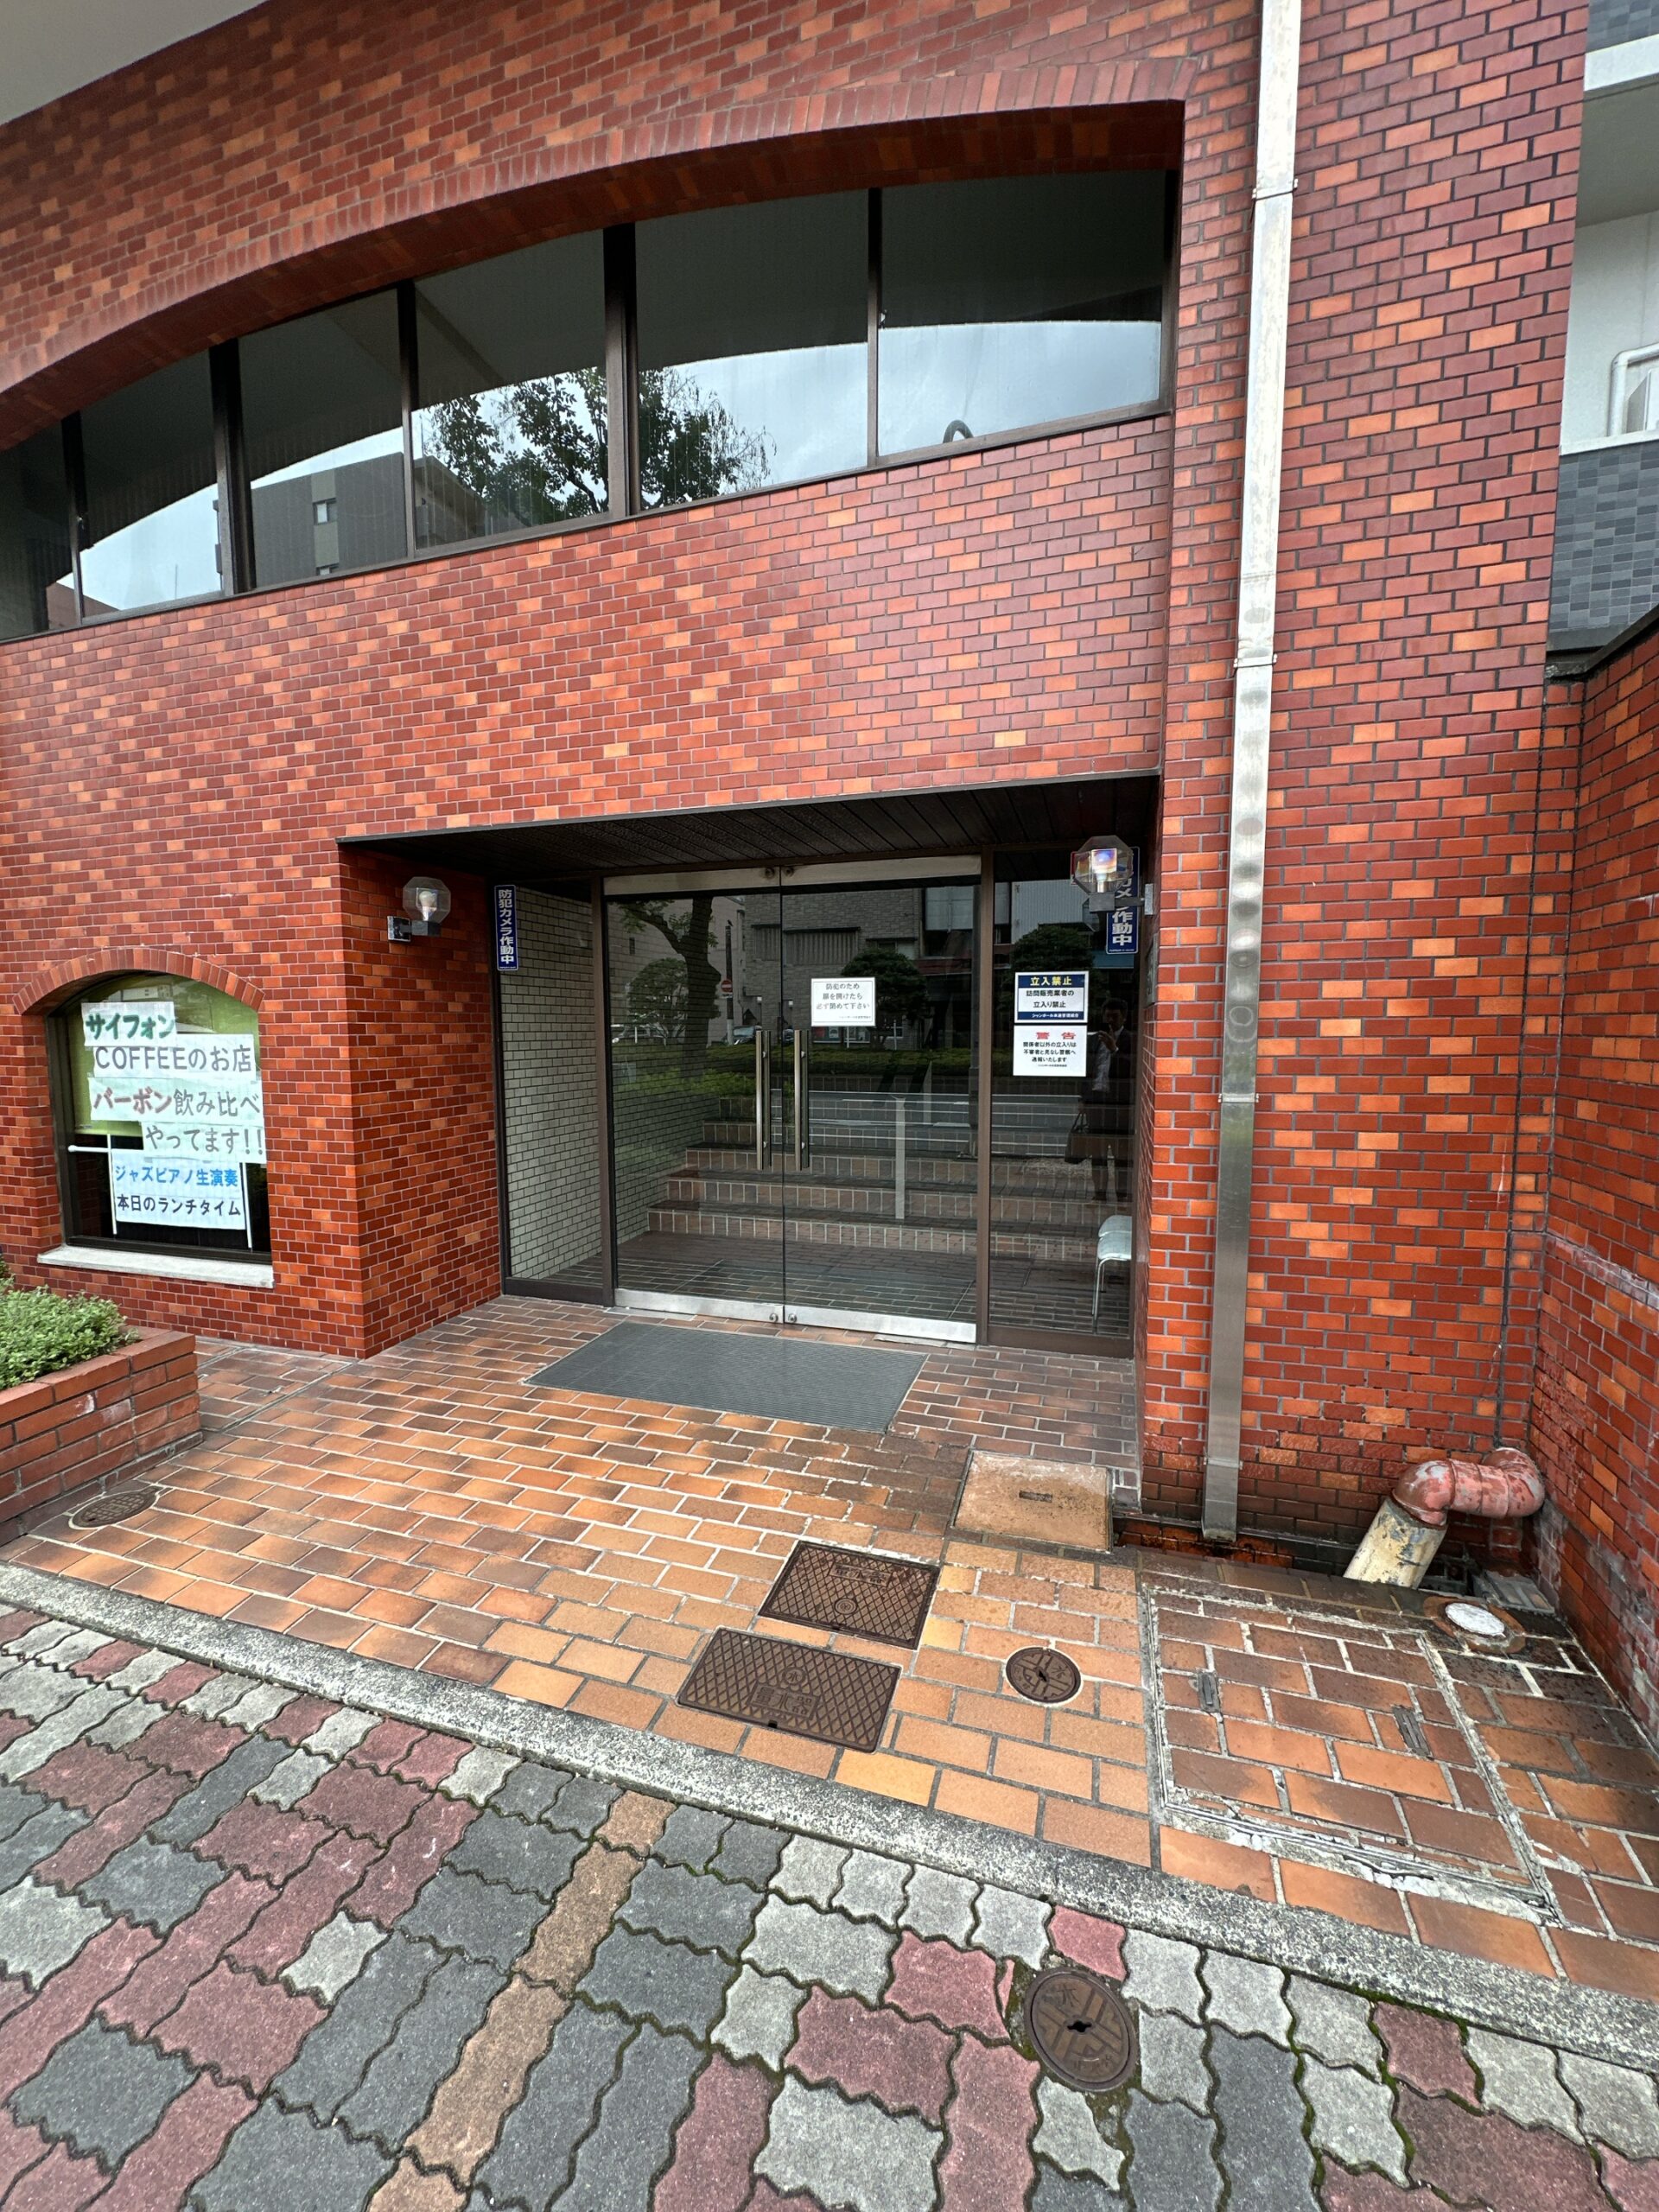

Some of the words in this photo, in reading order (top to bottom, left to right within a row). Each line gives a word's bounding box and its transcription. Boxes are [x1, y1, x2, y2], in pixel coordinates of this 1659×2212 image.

[498, 889, 514, 964] 防犯カメラ作動中
[1030, 976, 1072, 987] 立入禁止
[85, 1013, 175, 1040] サイフォン
[95, 1045, 252, 1073] COFFEEのお店
[93, 1085, 260, 1117] バーボン飲み比べ
[115, 1166, 238, 1187] ジャズピアノ生演奏
[118, 1194, 242, 1217] 本日のランチタイム
[755, 1687, 813, 1716] 量水器
